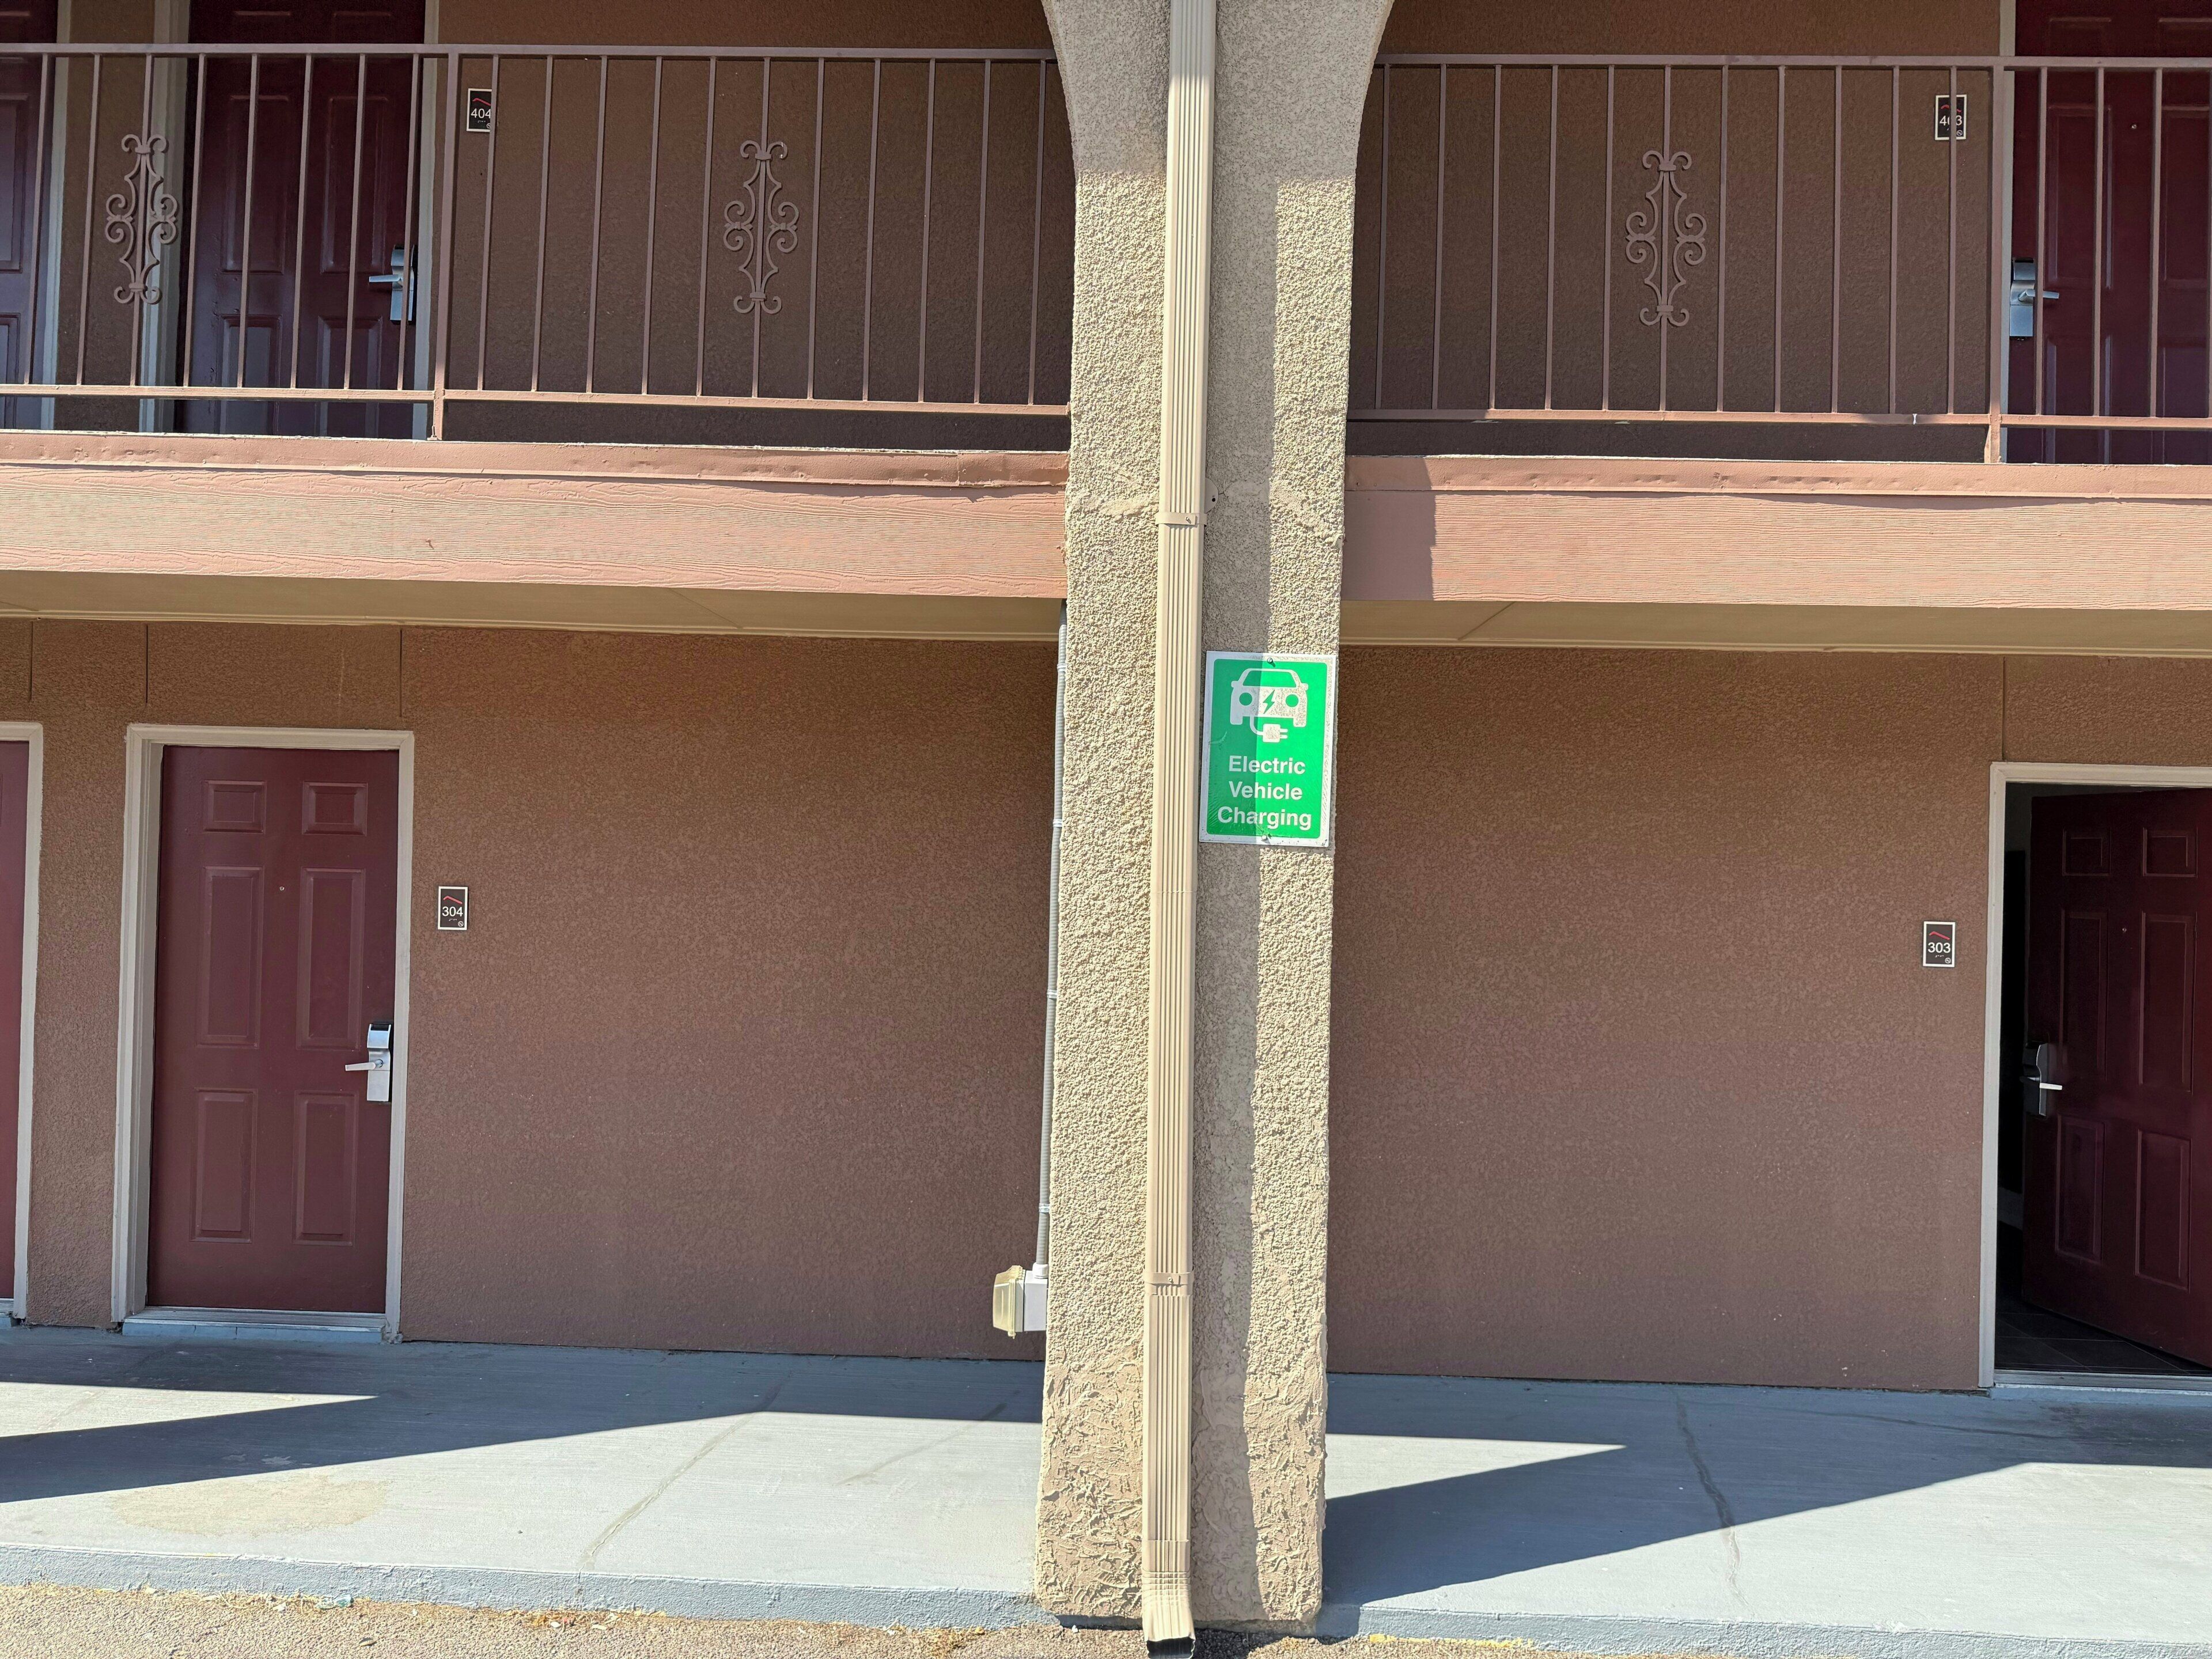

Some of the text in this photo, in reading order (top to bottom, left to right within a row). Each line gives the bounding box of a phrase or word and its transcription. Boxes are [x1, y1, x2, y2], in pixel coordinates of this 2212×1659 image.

[471, 108, 491, 119] 404
[1229, 755, 1305, 774] Electric
[1229, 781, 1302, 800] Vehicle
[1218, 806, 1312, 831] Charging
[442, 906, 463, 916] 304
[1927, 942, 1951, 953] 303
